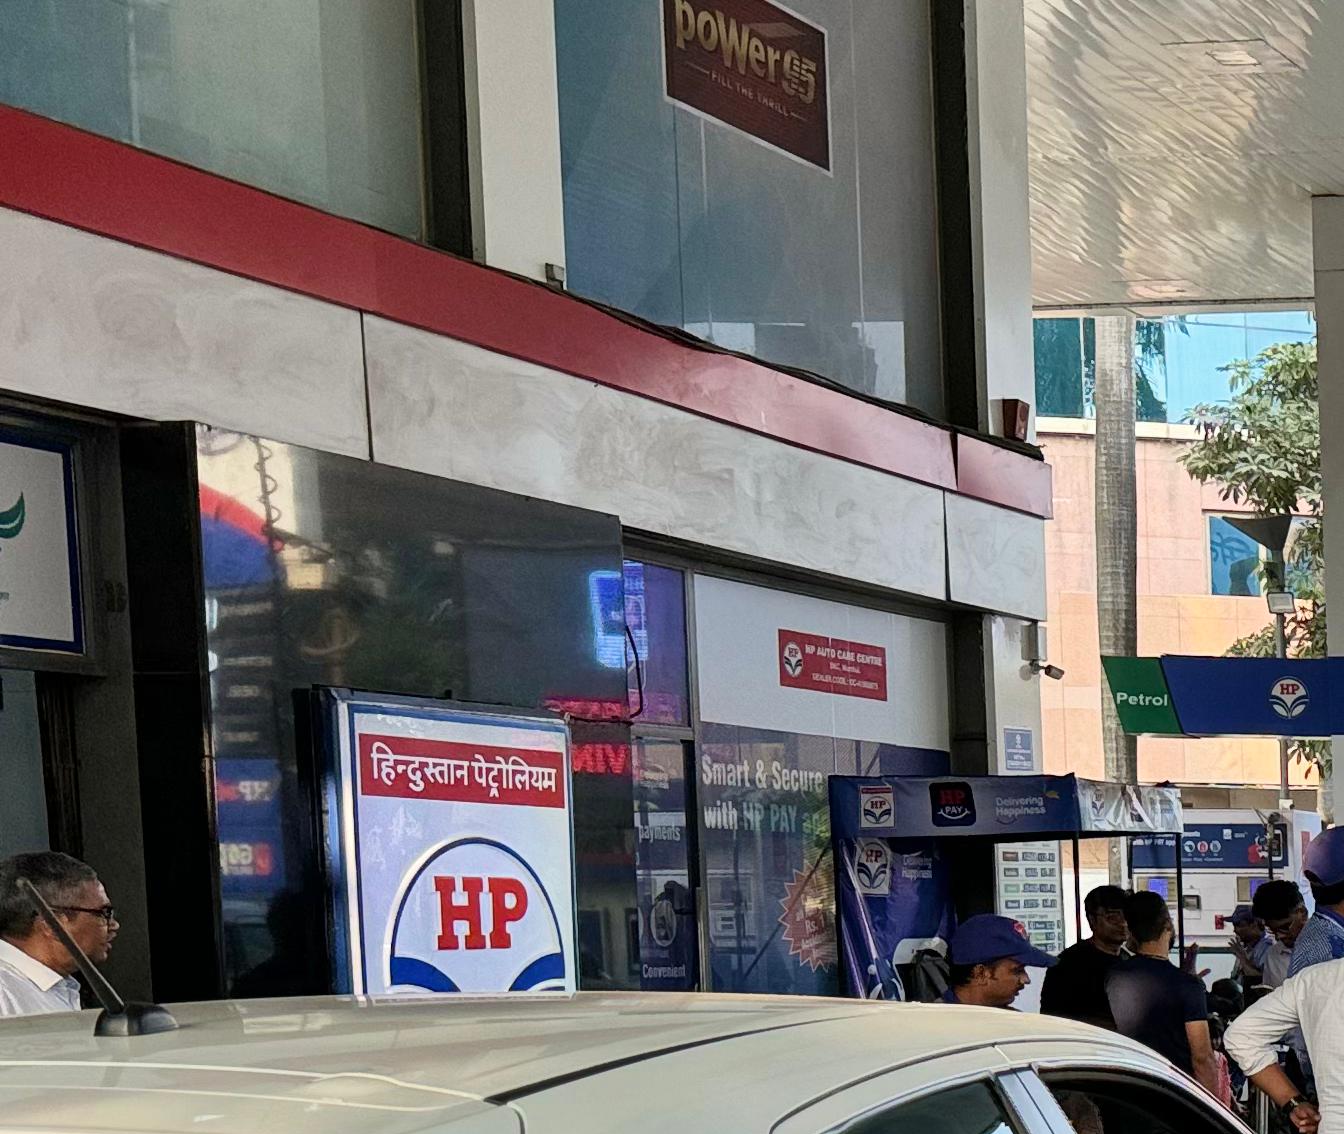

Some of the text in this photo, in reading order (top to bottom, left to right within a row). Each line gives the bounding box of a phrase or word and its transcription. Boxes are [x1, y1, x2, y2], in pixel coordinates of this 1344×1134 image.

[817, 646, 836, 659] AUTO
[837, 649, 856, 662] CARE
[857, 653, 882, 666] CENTRE
[1279, 683, 1300, 696] HP
[1116, 692, 1168, 708] Petrol
[370, 742, 558, 798] हिन्दुस्तान पेट्रोलियम
[702, 753, 751, 788] Smart
[755, 759, 768, 789] &
[772, 760, 825, 794] Secure
[940, 788, 966, 804] HP
[996, 796, 1044, 807] Delivering
[870, 800, 887, 810] HP
[944, 806, 963, 815] PAY
[996, 806, 1046, 818] Happiness
[703, 800, 738, 831] with
[742, 801, 765, 831] HP
[770, 803, 799, 833] PAY
[638, 824, 681, 844] payments
[865, 849, 883, 864] HP
[434, 875, 529, 951] HP
[642, 963, 686, 979] Convenient
